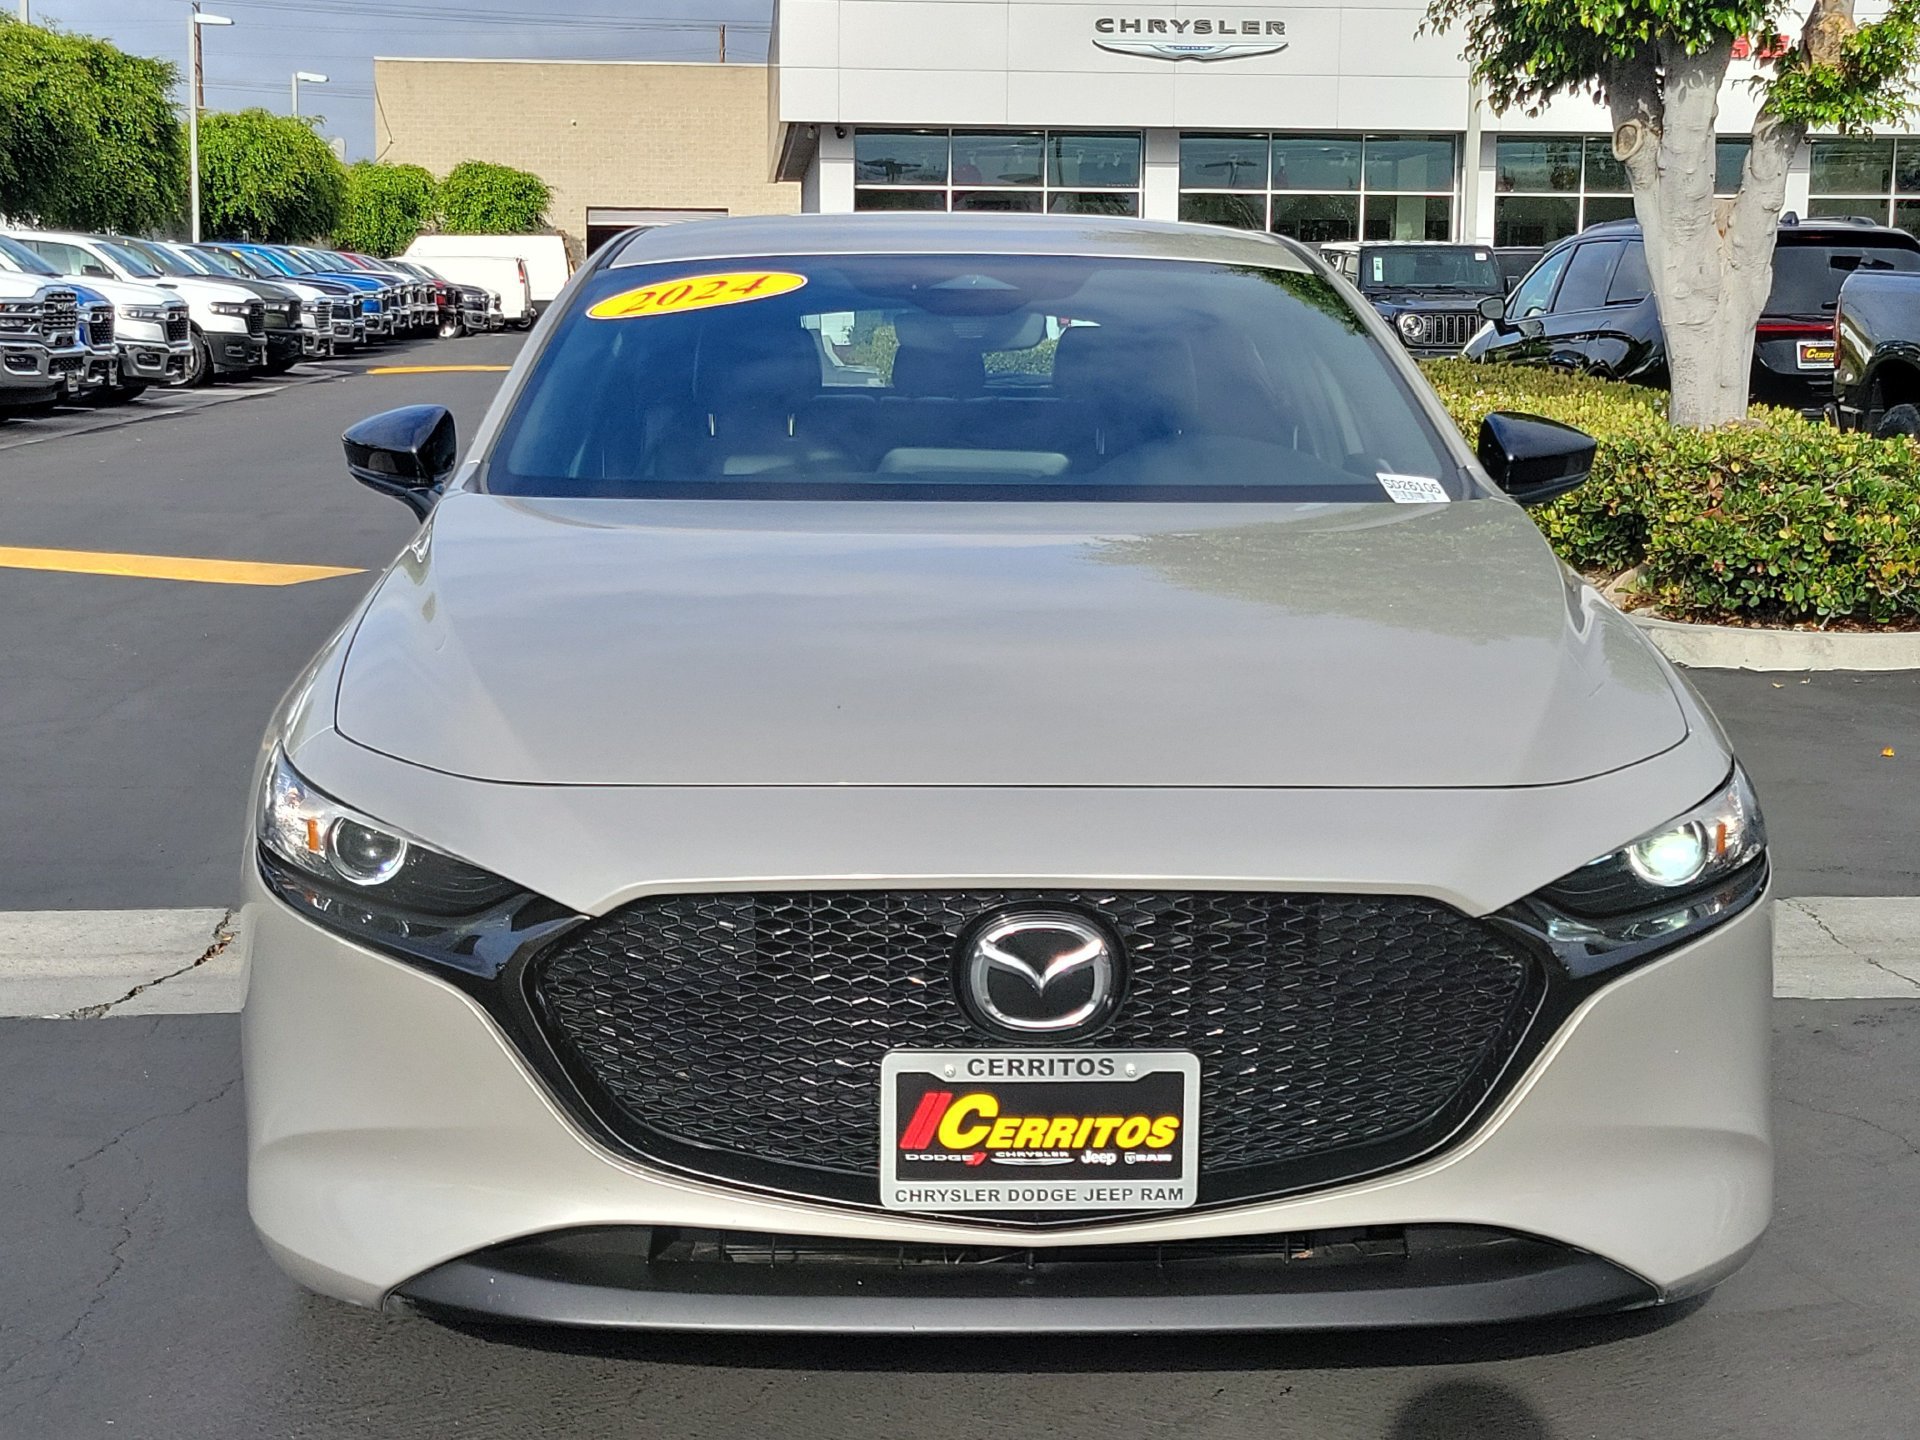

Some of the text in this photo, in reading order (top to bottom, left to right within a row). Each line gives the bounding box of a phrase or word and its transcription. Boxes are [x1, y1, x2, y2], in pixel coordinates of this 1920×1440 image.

[1095, 18, 1286, 35] CHRYSLER
[617, 275, 771, 314] 2024
[1383, 479, 1441, 494] SD26105
[967, 1058, 1115, 1077] CERRITOS
[938, 1094, 1180, 1149] CERRITOS
[905, 1153, 974, 1162] DODGE
[1080, 1150, 1117, 1165] Jeep
[1136, 1153, 1172, 1162] RAM
[895, 1187, 1184, 1203] CHRYSLER DODGE JEEP RAM
